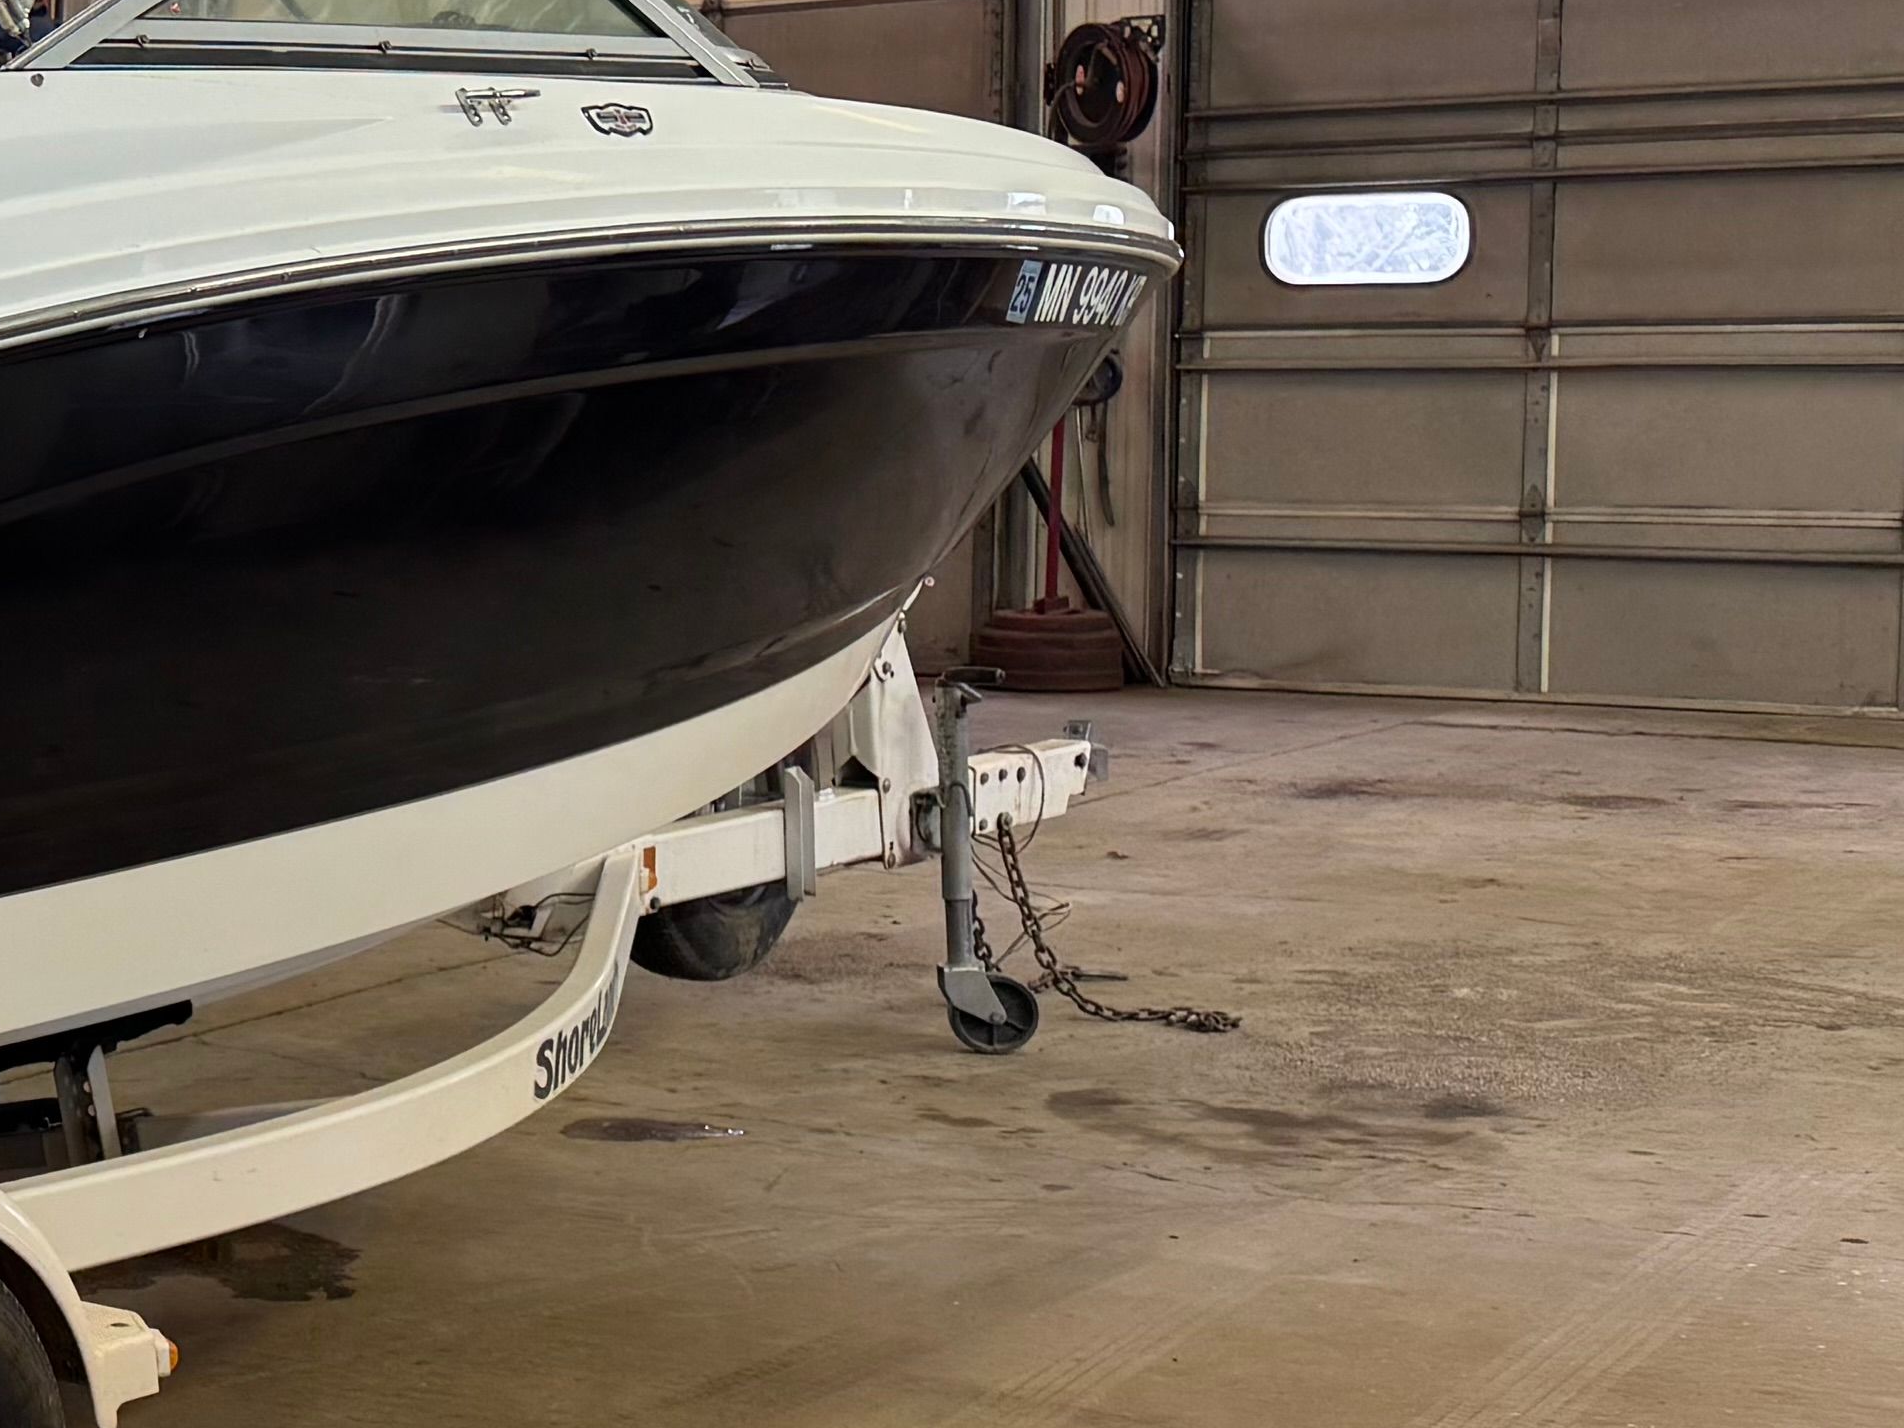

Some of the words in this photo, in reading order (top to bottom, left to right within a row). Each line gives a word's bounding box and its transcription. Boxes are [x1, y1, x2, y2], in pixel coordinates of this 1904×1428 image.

[1010, 274, 1035, 313] 25
[1034, 263, 1082, 322] MN
[1072, 266, 1128, 325] 9940
